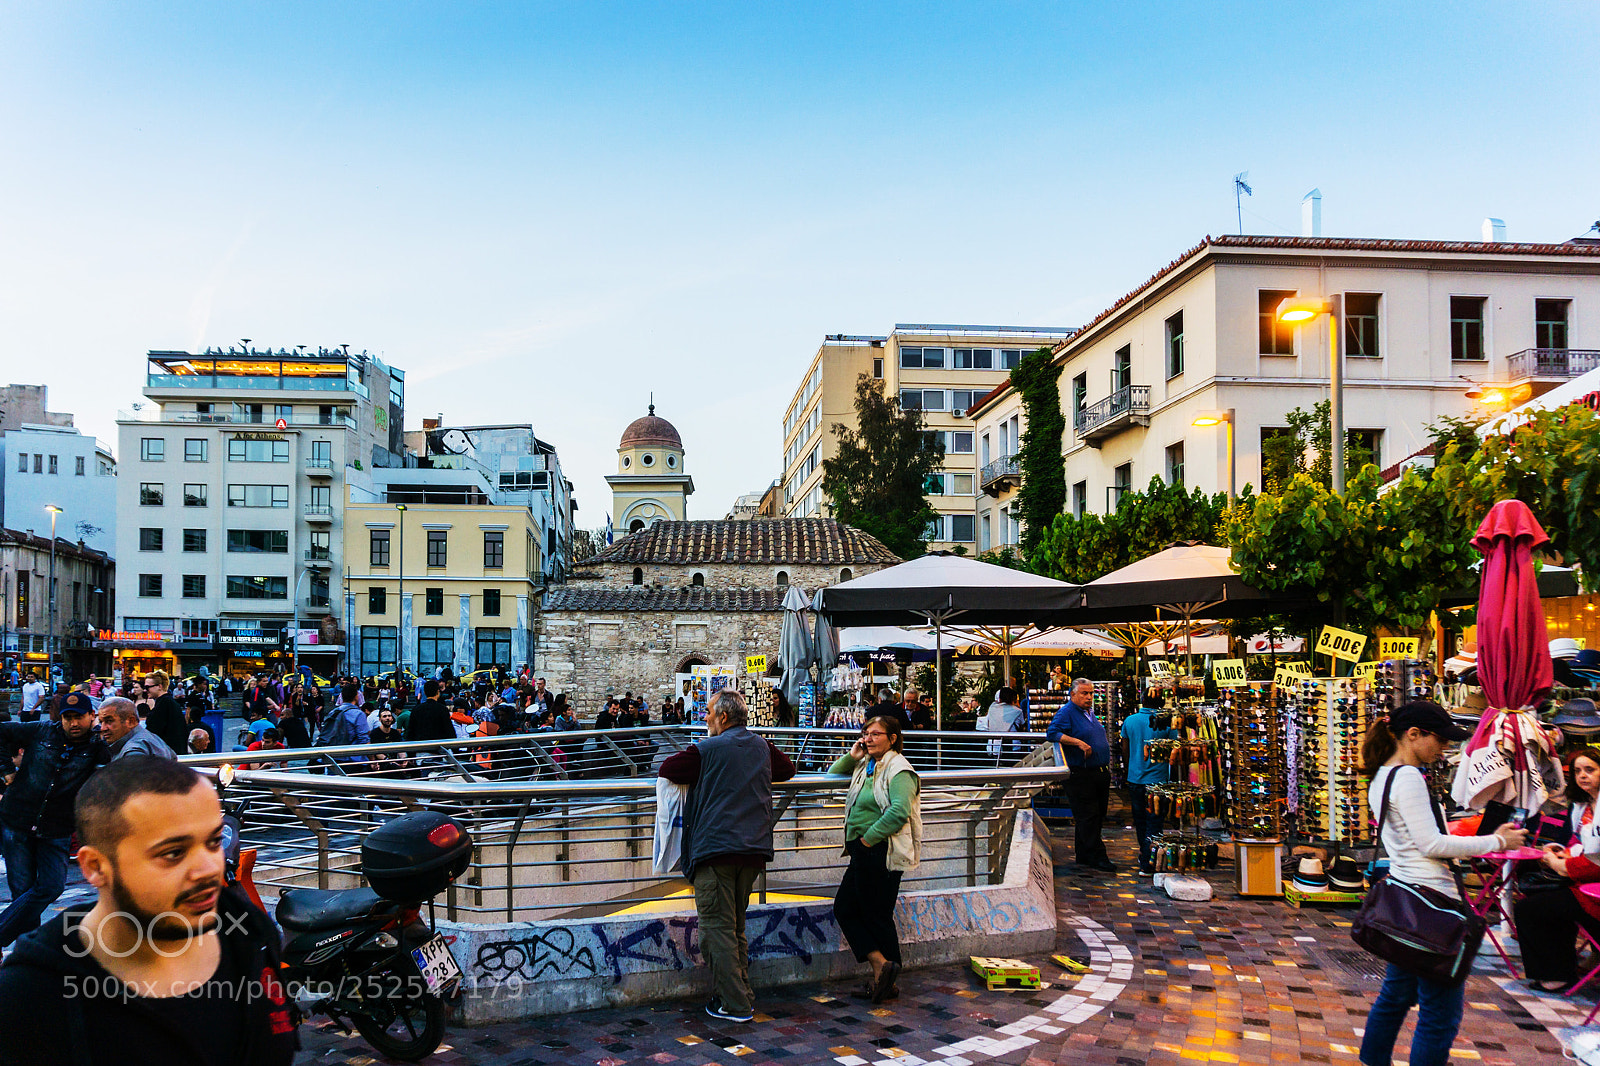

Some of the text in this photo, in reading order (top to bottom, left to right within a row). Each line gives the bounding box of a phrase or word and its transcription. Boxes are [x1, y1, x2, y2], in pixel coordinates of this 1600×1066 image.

[1320, 632, 1361, 655] 3.00€
[1382, 641, 1414, 654] 3.00€
[1100, 649, 1114, 657] Pils
[1215, 666, 1244, 681] 3.00€
